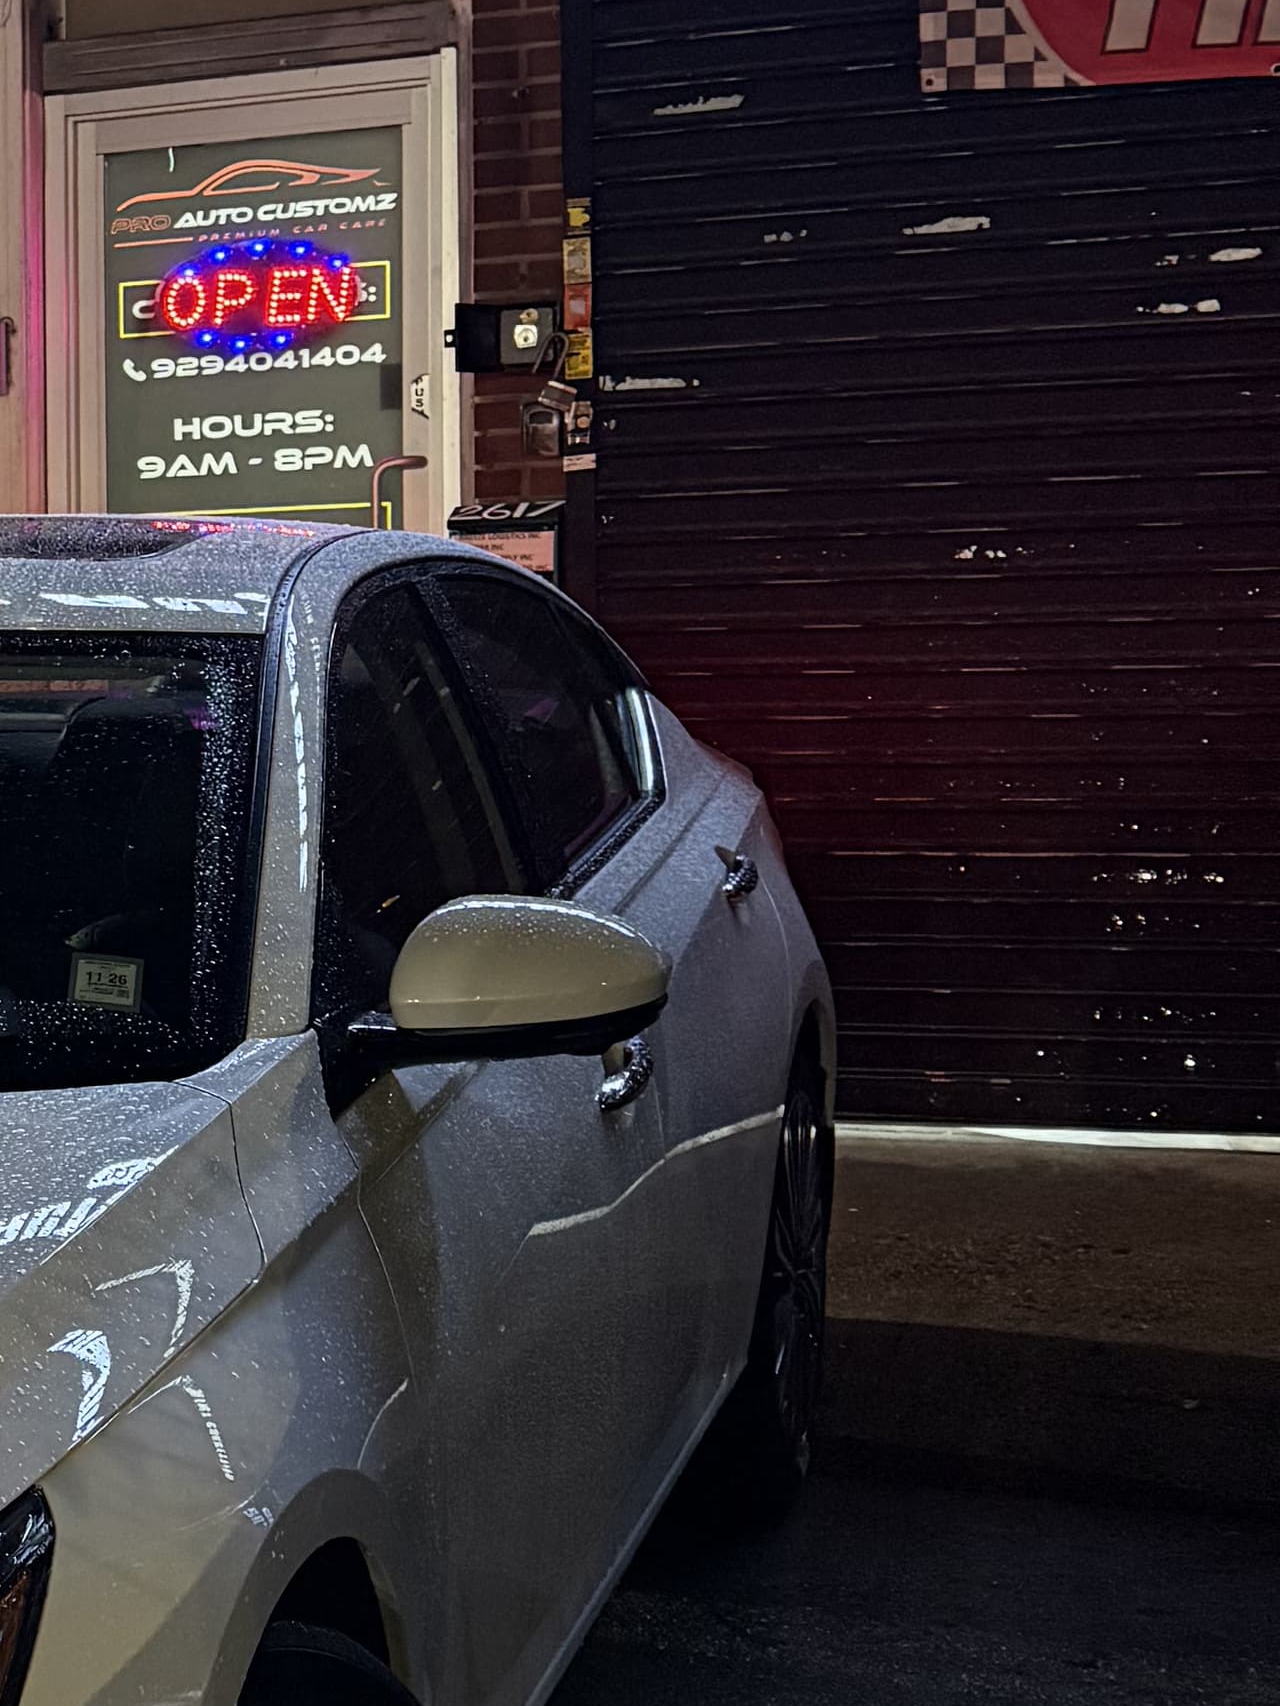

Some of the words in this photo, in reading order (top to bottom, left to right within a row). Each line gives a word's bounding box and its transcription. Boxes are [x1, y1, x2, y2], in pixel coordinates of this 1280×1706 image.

[111, 215, 171, 234] PRO
[173, 207, 254, 230] AUTO
[257, 193, 398, 221] CUSTOMZ
[198, 228, 280, 242] PREMIUM
[293, 223, 327, 234] CAR
[340, 218, 386, 230] CARE
[161, 265, 354, 331] OPEN
[151, 343, 387, 379] 9294041404
[174, 410, 334, 441] HOURS:
[138, 451, 238, 479] 9AM
[274, 444, 374, 471] 8PM
[449, 500, 567, 520] 2617
[109, 972, 128, 985] 26
